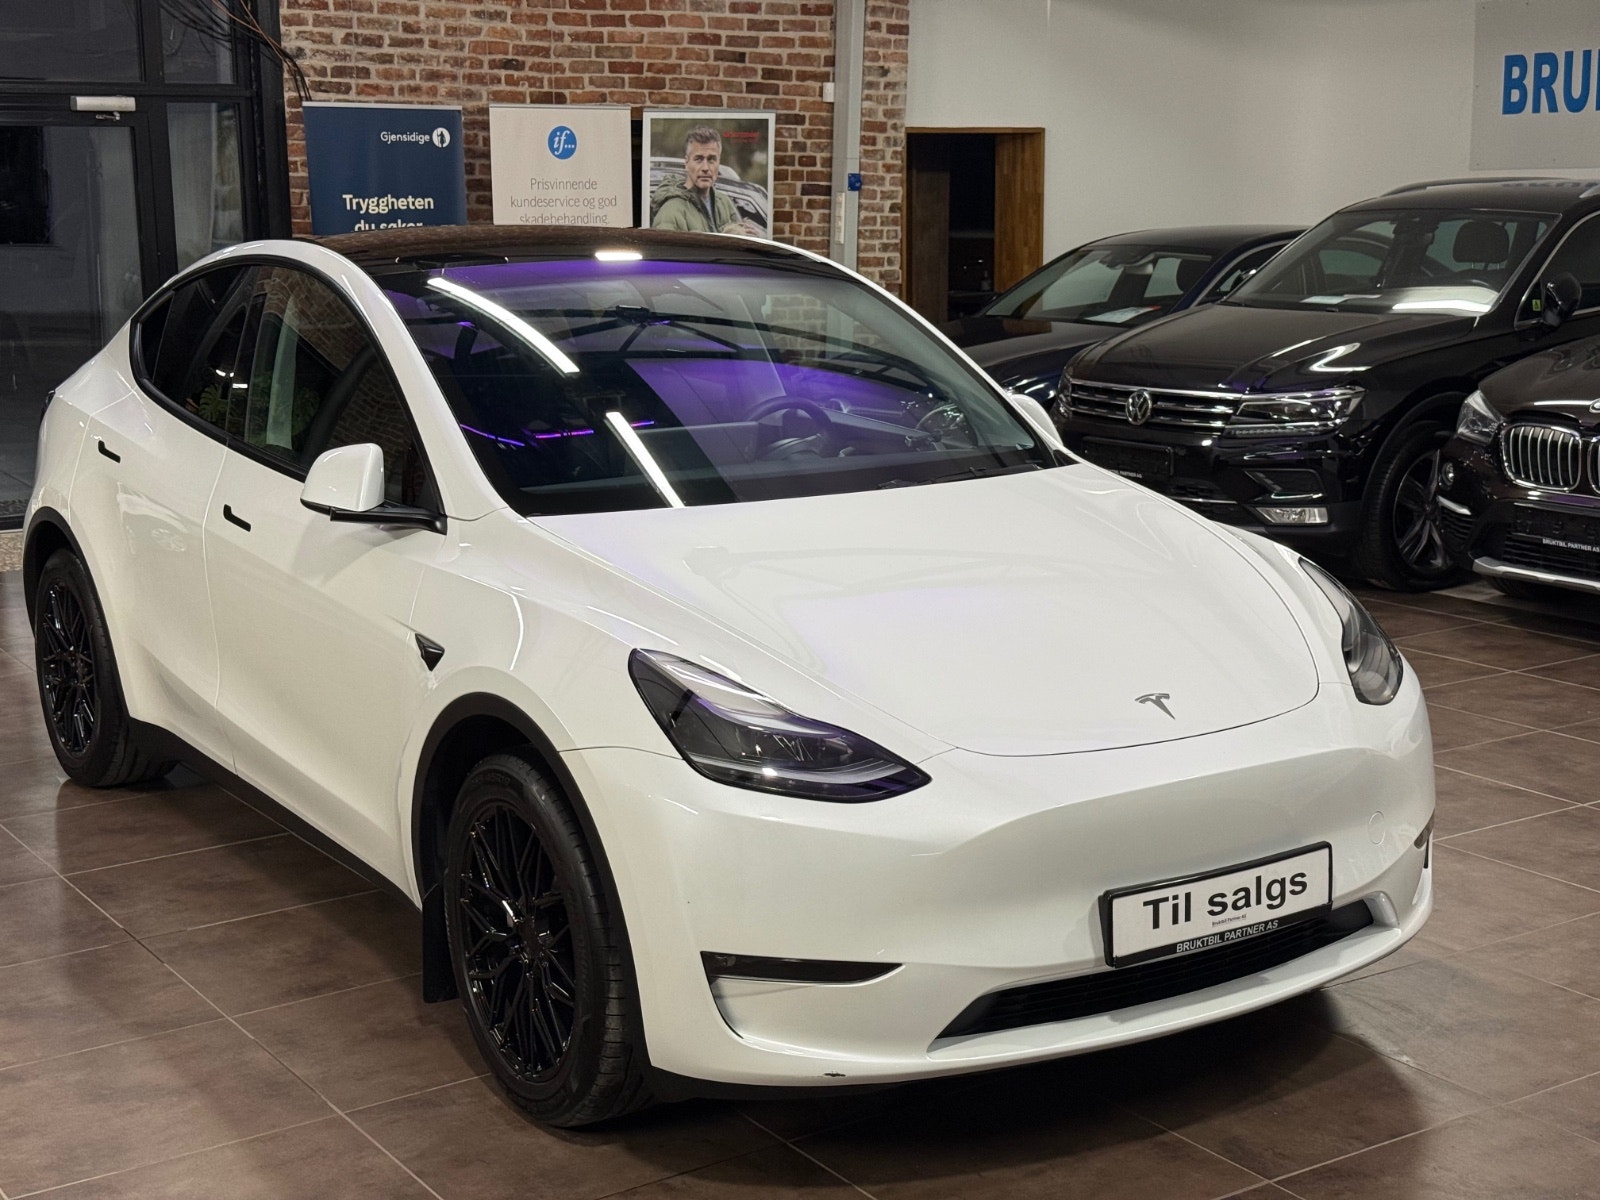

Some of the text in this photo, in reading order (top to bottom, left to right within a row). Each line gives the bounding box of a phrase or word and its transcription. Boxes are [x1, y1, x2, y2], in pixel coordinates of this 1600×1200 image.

[1501, 49, 1600, 116] BRU
[380, 131, 430, 144] Gjensidige
[530, 178, 598, 190] Prisvinnende
[342, 194, 434, 214] Tryggheten
[510, 195, 617, 210] kundeservice og god
[354, 219, 375, 231] du
[1142, 871, 1308, 930] Til salgs
[1176, 919, 1279, 953] BRUKTBIL PARTNER AS
